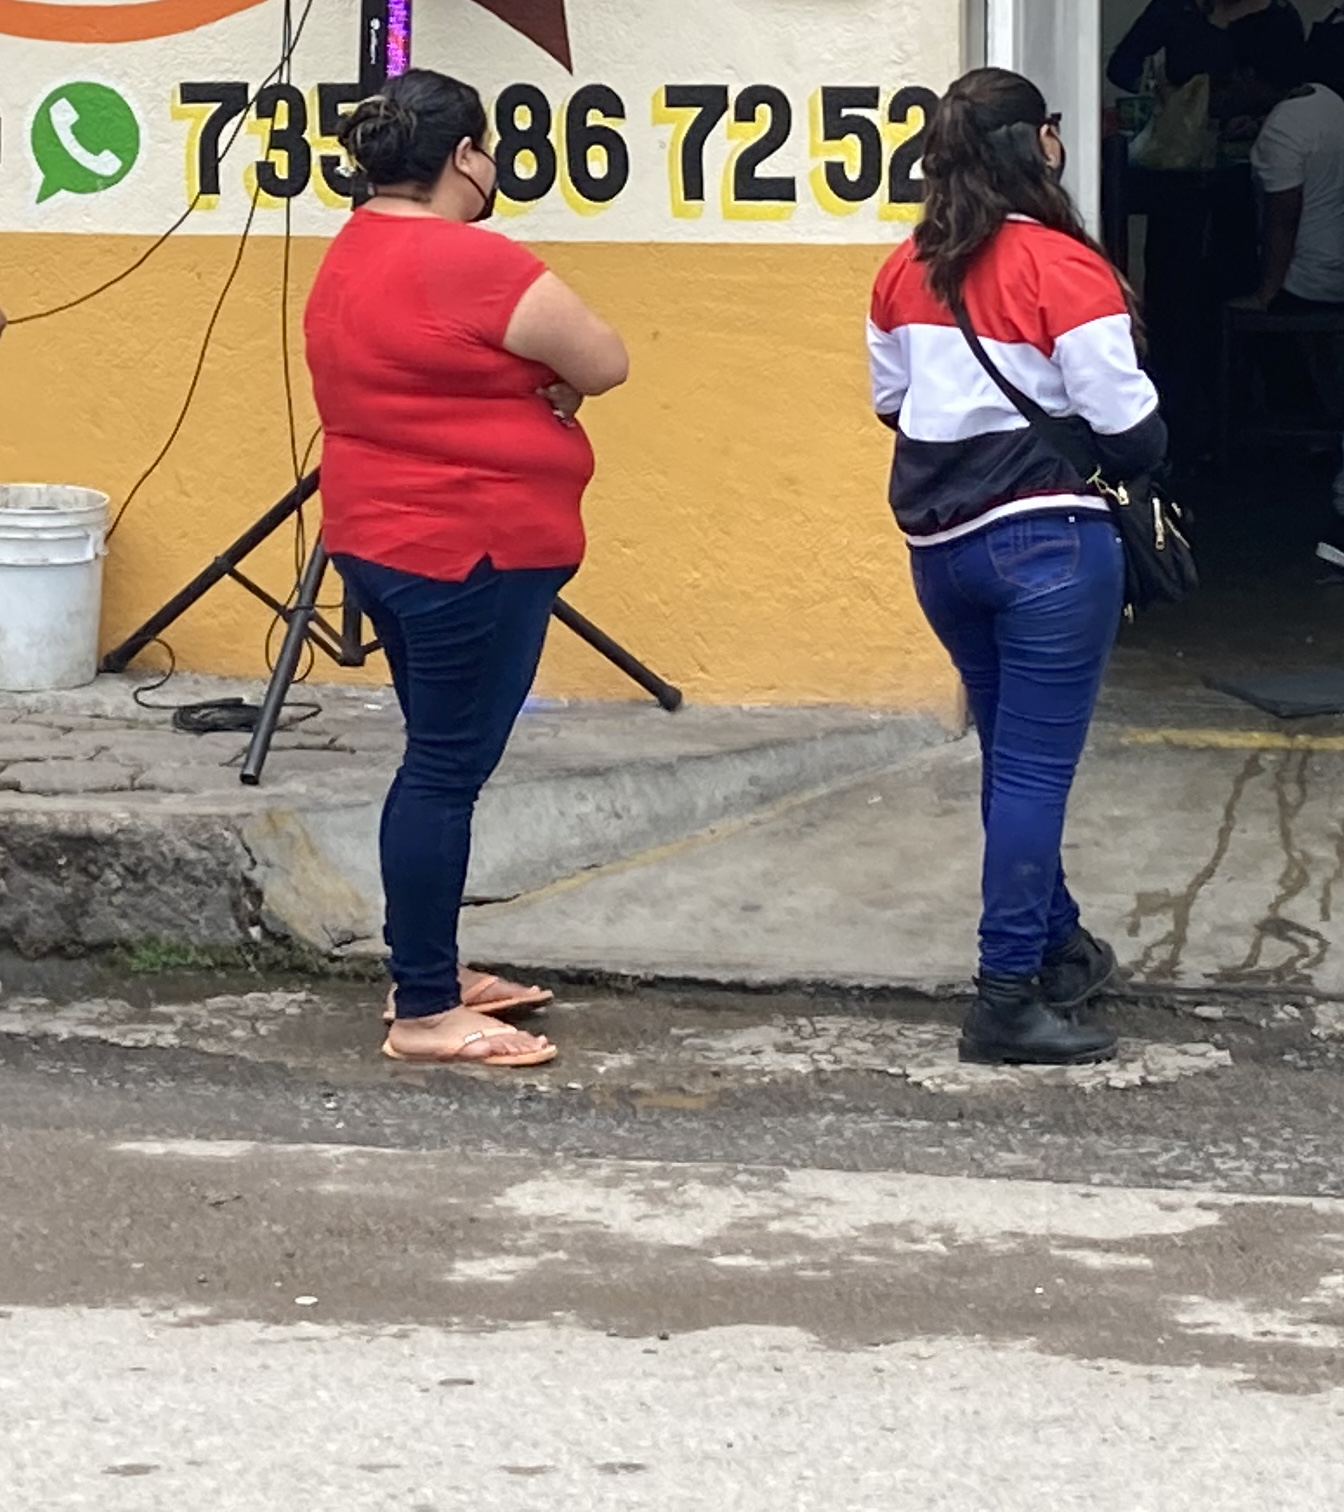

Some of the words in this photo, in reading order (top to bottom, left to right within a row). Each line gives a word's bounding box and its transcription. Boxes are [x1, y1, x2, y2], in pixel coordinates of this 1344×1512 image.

[177, 81, 368, 201] 735
[493, 83, 631, 204] 86
[663, 84, 798, 204] 72
[820, 85, 939, 205] 52
